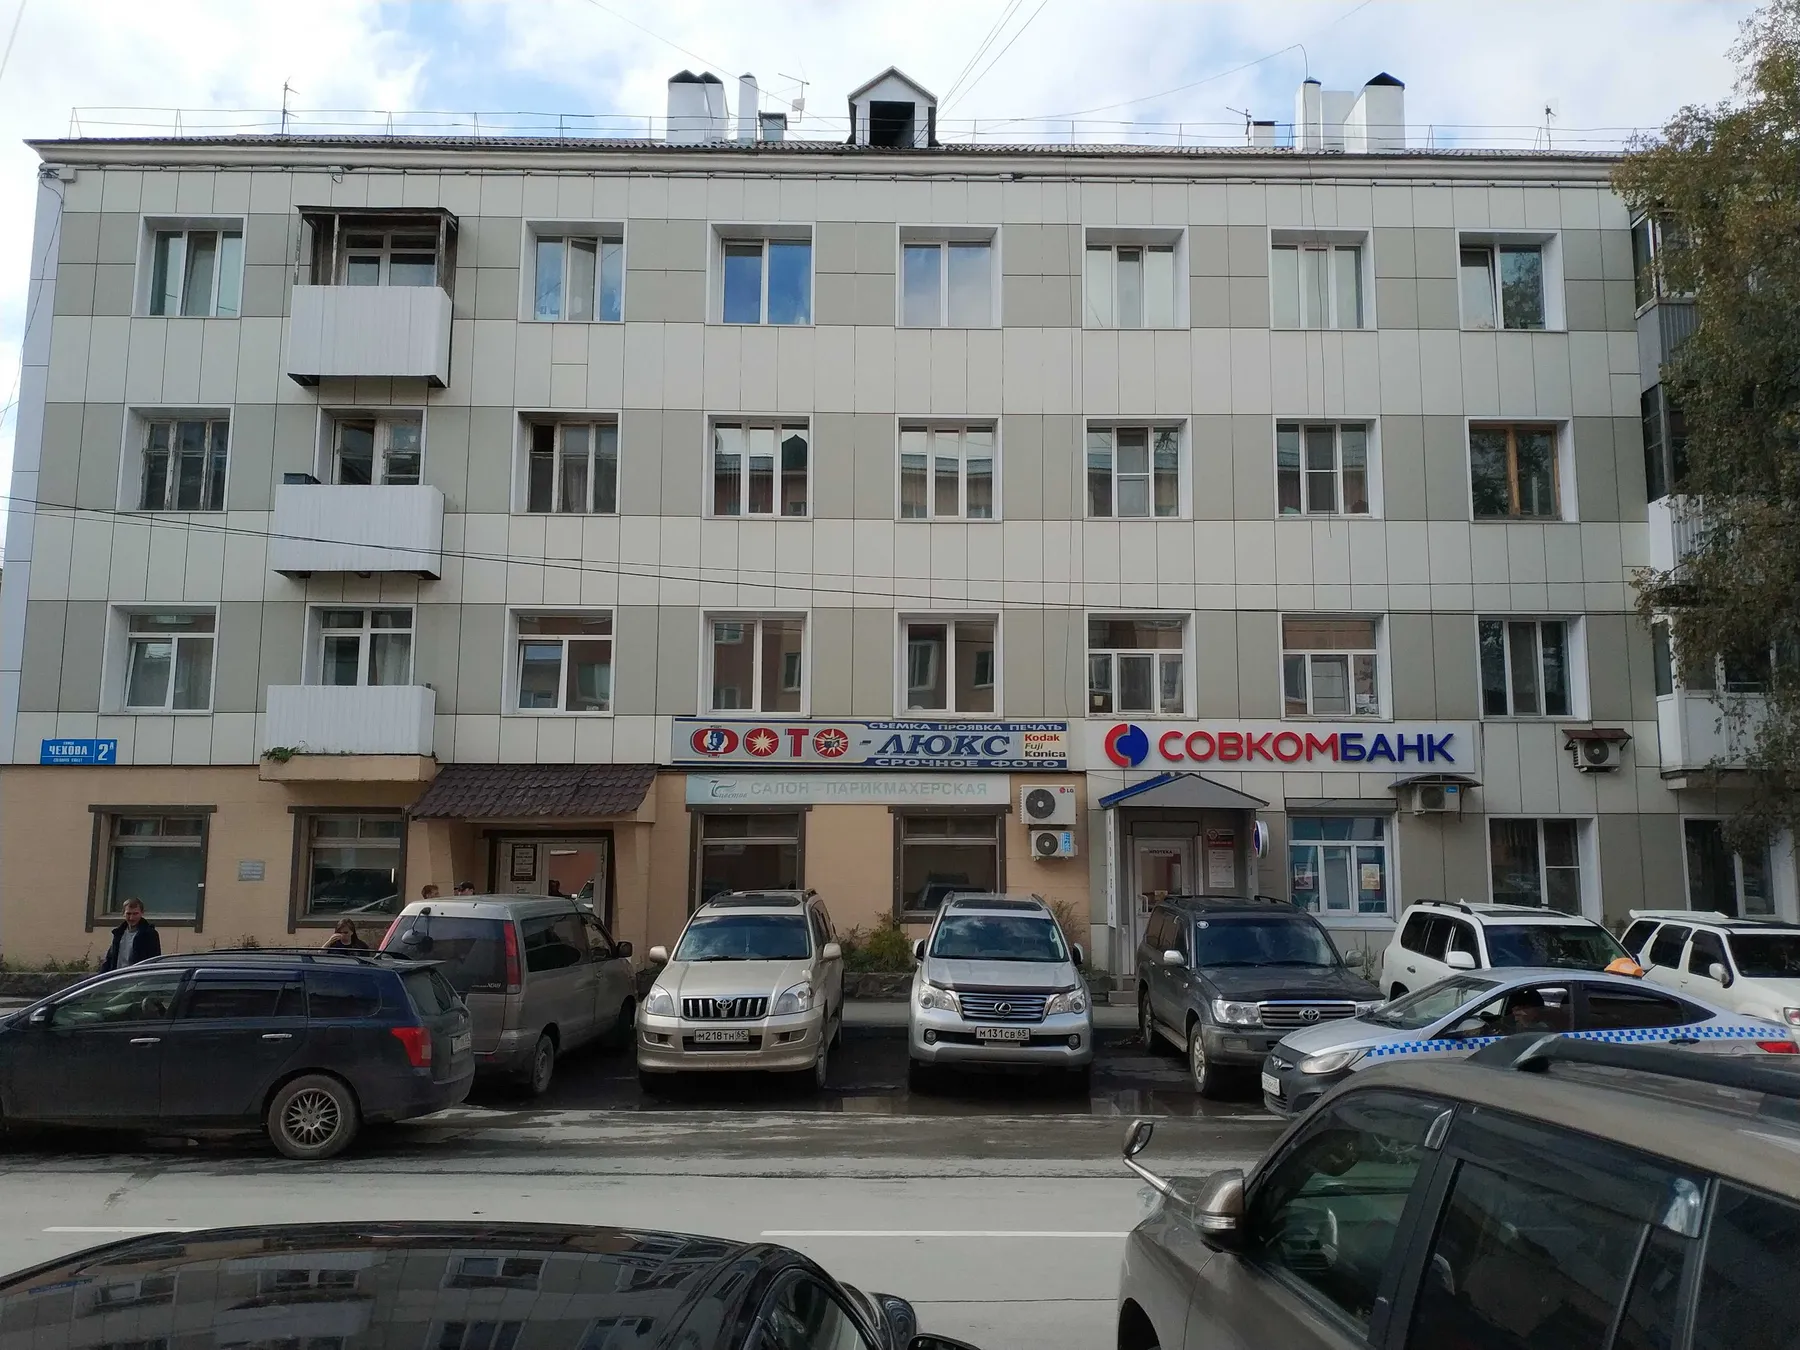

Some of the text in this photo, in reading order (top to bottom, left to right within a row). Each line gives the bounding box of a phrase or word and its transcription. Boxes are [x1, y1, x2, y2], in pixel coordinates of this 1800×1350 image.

[869, 722, 931, 730] СЪЕМКА
[1024, 734, 1060, 742] Kodak
[49, 745, 88, 755] ЧЕХОВА
[1024, 743, 1044, 751] Fuji
[1158, 730, 1455, 762] СОВКОМБАНК
[875, 758, 1059, 768] СРОЧНОЕ ФОТО
[751, 781, 809, 795] САЛОН
[826, 781, 987, 795] ПАРИКМАХЕРСКАЯ
